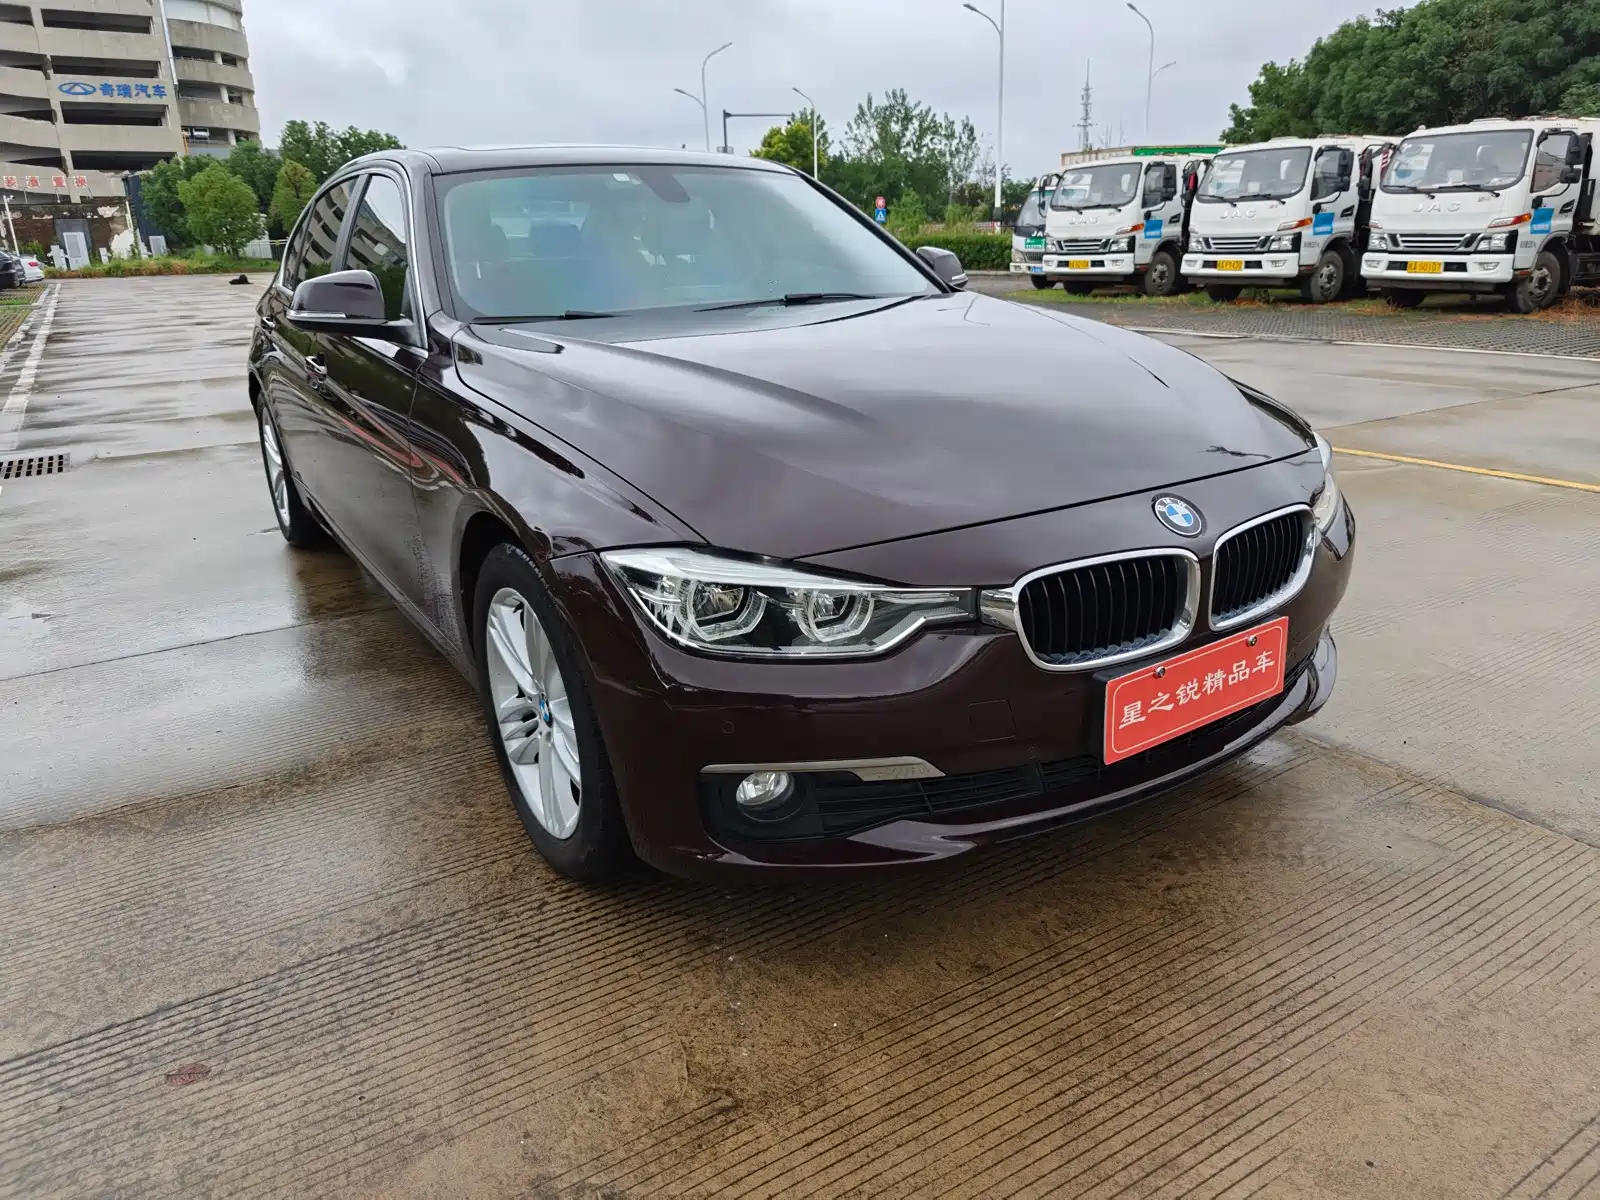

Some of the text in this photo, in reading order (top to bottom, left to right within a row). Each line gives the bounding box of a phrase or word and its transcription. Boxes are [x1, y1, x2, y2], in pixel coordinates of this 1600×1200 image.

[100, 83, 167, 99] 奇瑞汽车
[1413, 203, 1461, 212] JAC
[1220, 208, 1256, 219] JAC
[1069, 216, 1099, 225] JAC
[1118, 650, 1275, 730] 星之锐精品车
